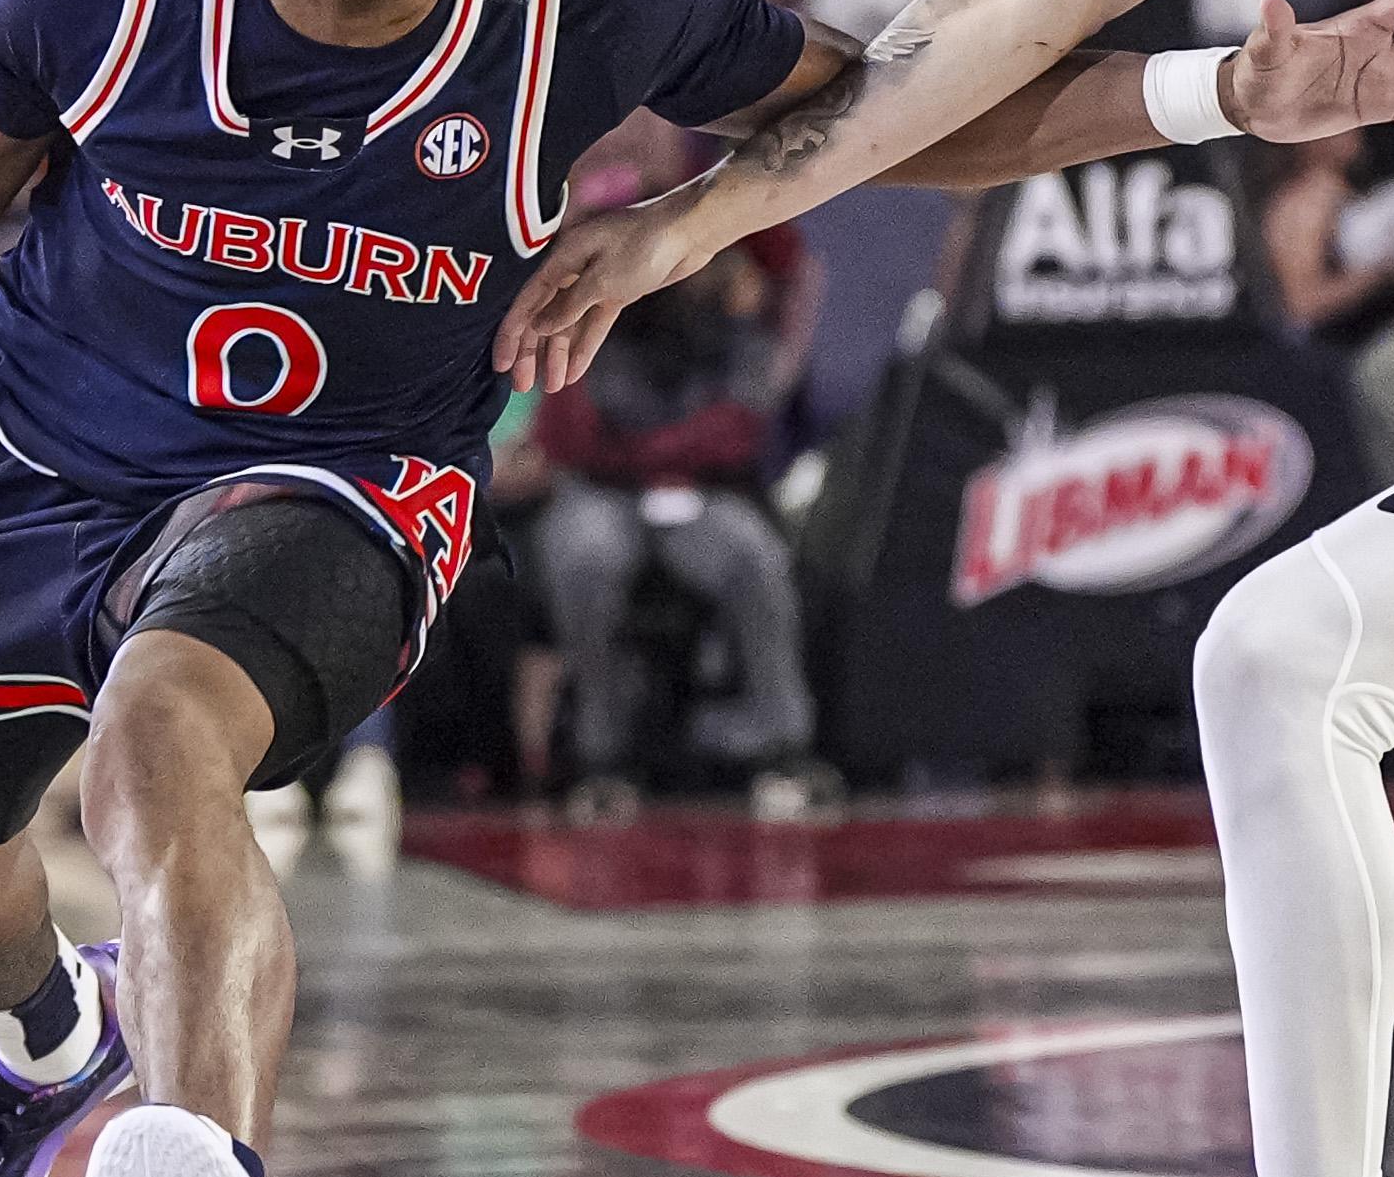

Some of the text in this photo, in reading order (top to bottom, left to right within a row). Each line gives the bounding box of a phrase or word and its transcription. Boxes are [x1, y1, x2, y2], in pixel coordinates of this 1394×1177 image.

[422, 119, 482, 175] SEC
[997, 158, 1238, 278] Alfa
[187, 302, 328, 416] 0
